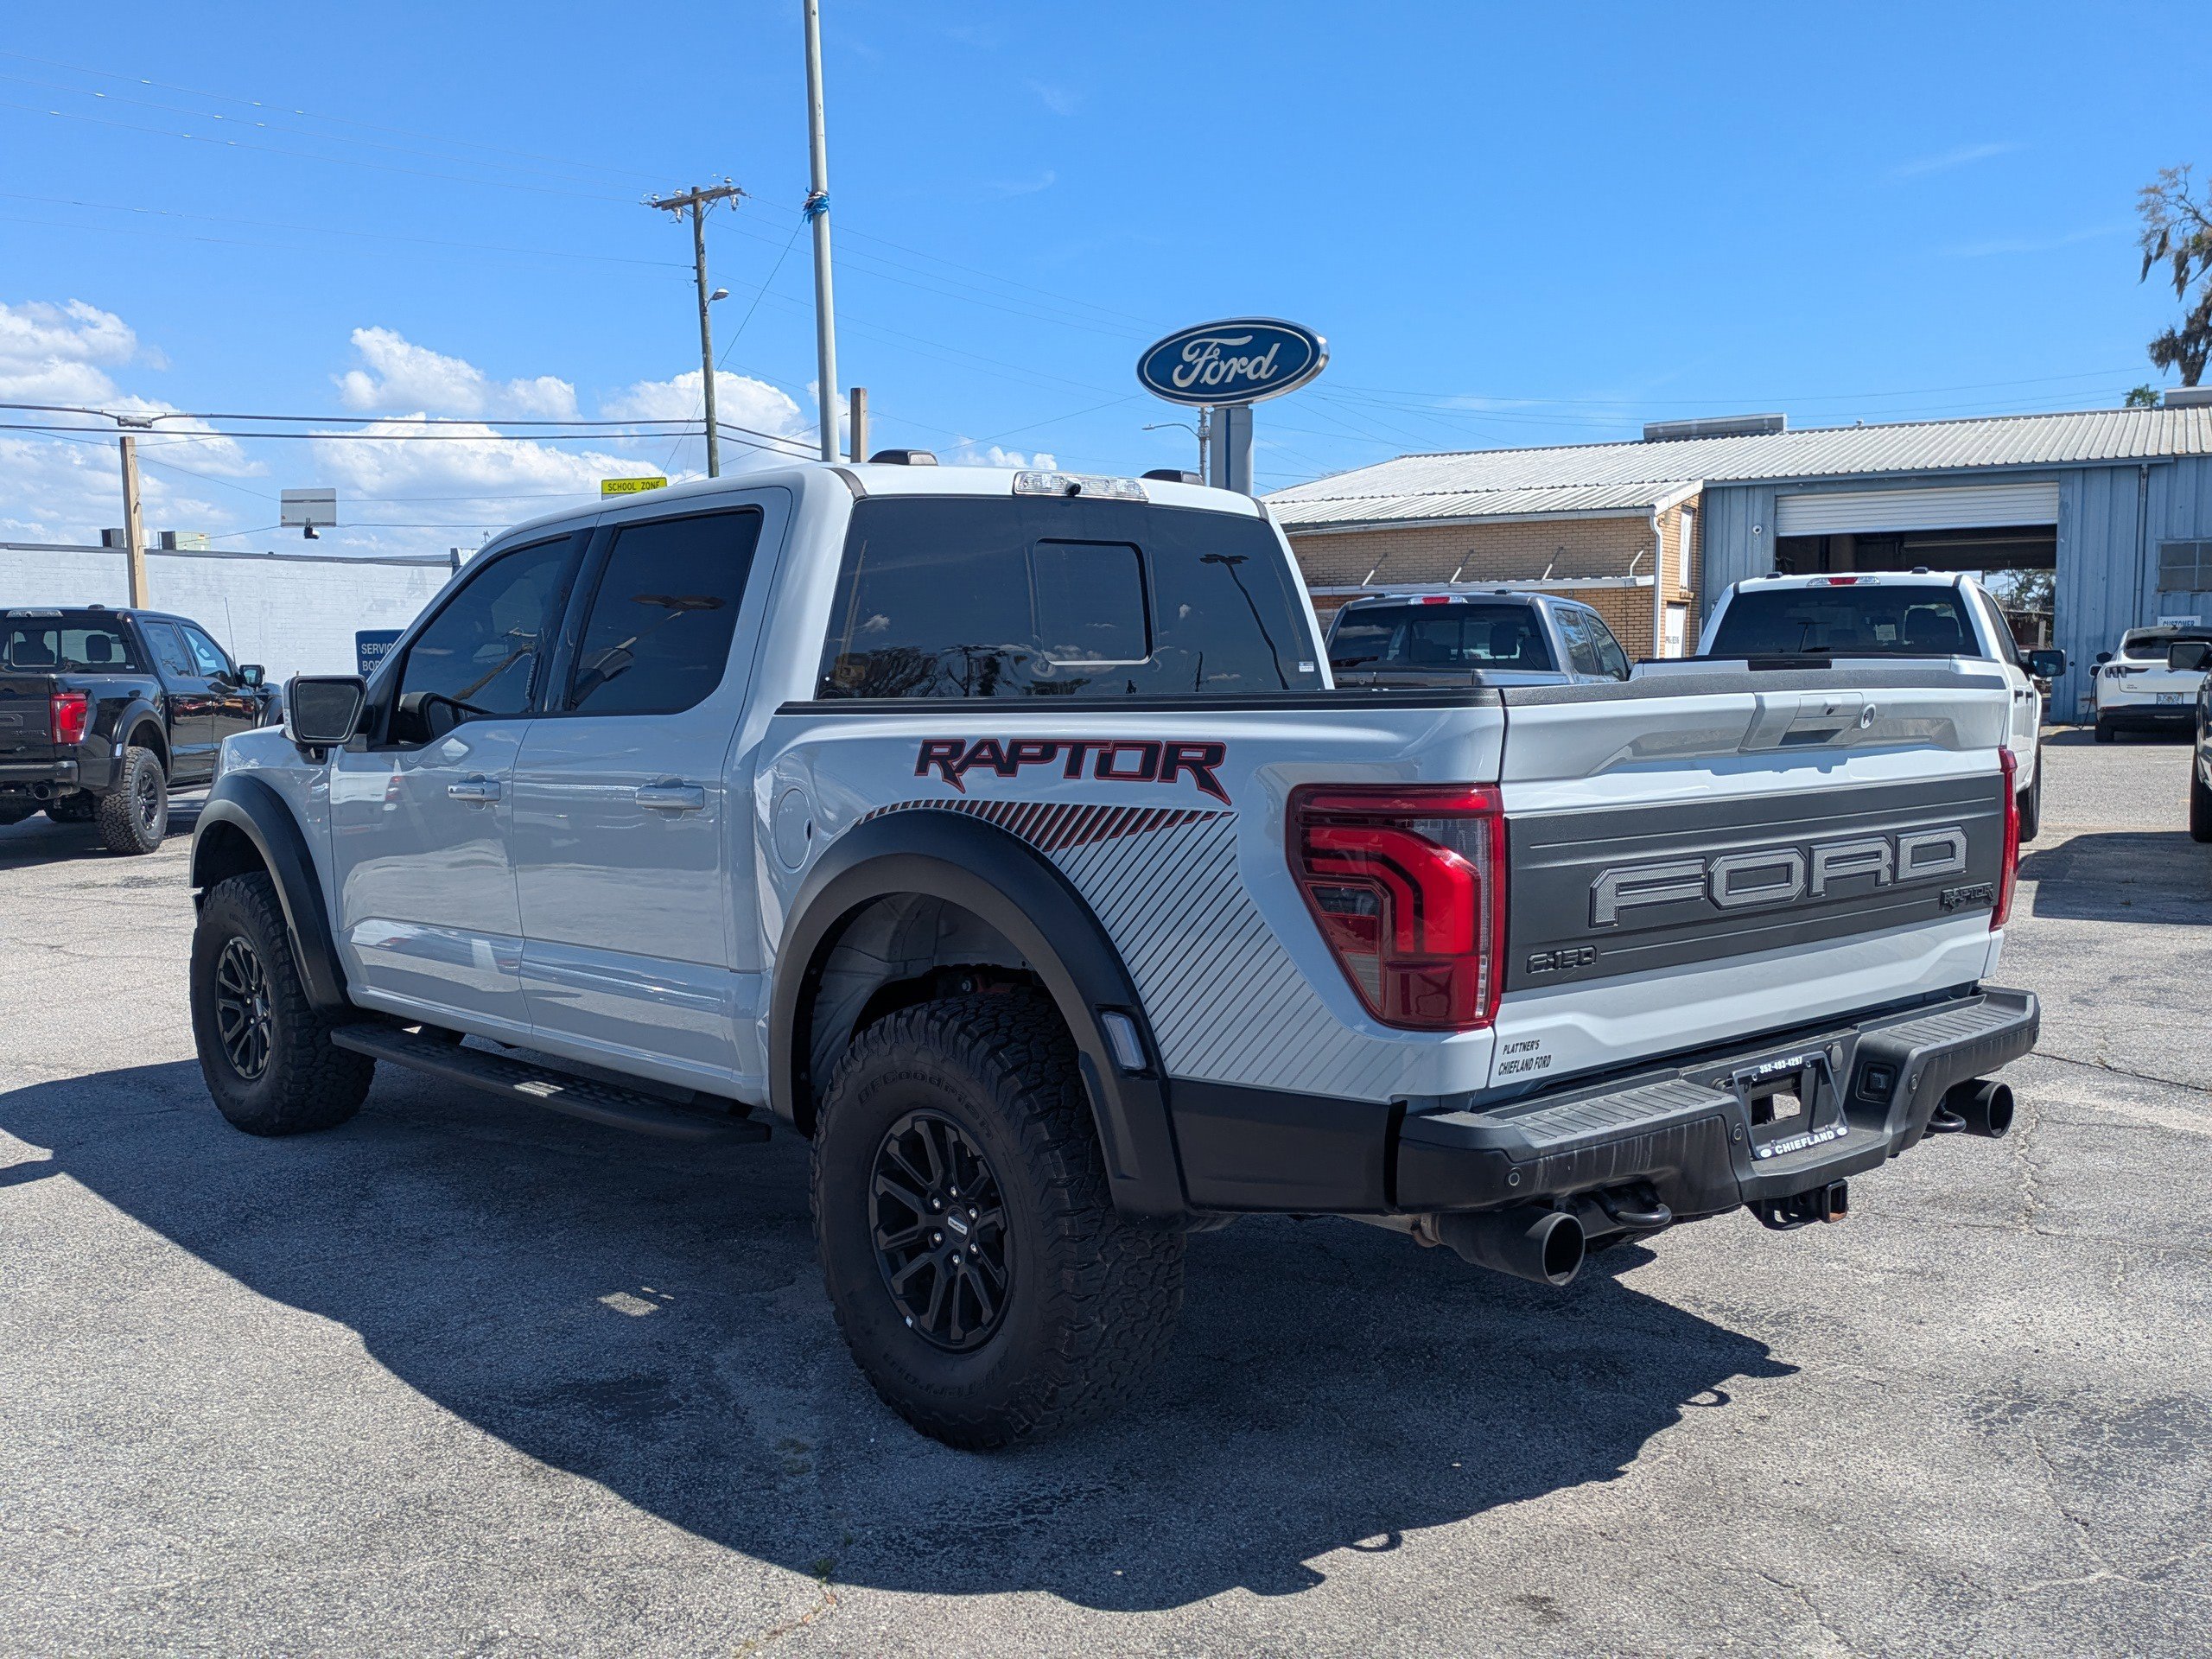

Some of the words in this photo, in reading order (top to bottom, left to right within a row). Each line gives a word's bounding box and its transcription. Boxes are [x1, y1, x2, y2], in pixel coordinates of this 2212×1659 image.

[1172, 334, 1281, 388] Ford
[607, 481, 636, 492] SCHOOL
[640, 480, 660, 491] ZONE
[361, 643, 393, 655] SERVIC
[914, 738, 1233, 806] RAPTOR
[1588, 825, 1968, 929] FORD
[1941, 881, 1994, 908] RAPTOR
[1526, 945, 1597, 974] F-150
[1503, 1039, 1541, 1055] PLATTNER'S
[1497, 1057, 1534, 1077] CHIEFLAND
[1534, 1054, 1552, 1071] FORD
[1774, 1130, 1835, 1155] CHIEFLAND
